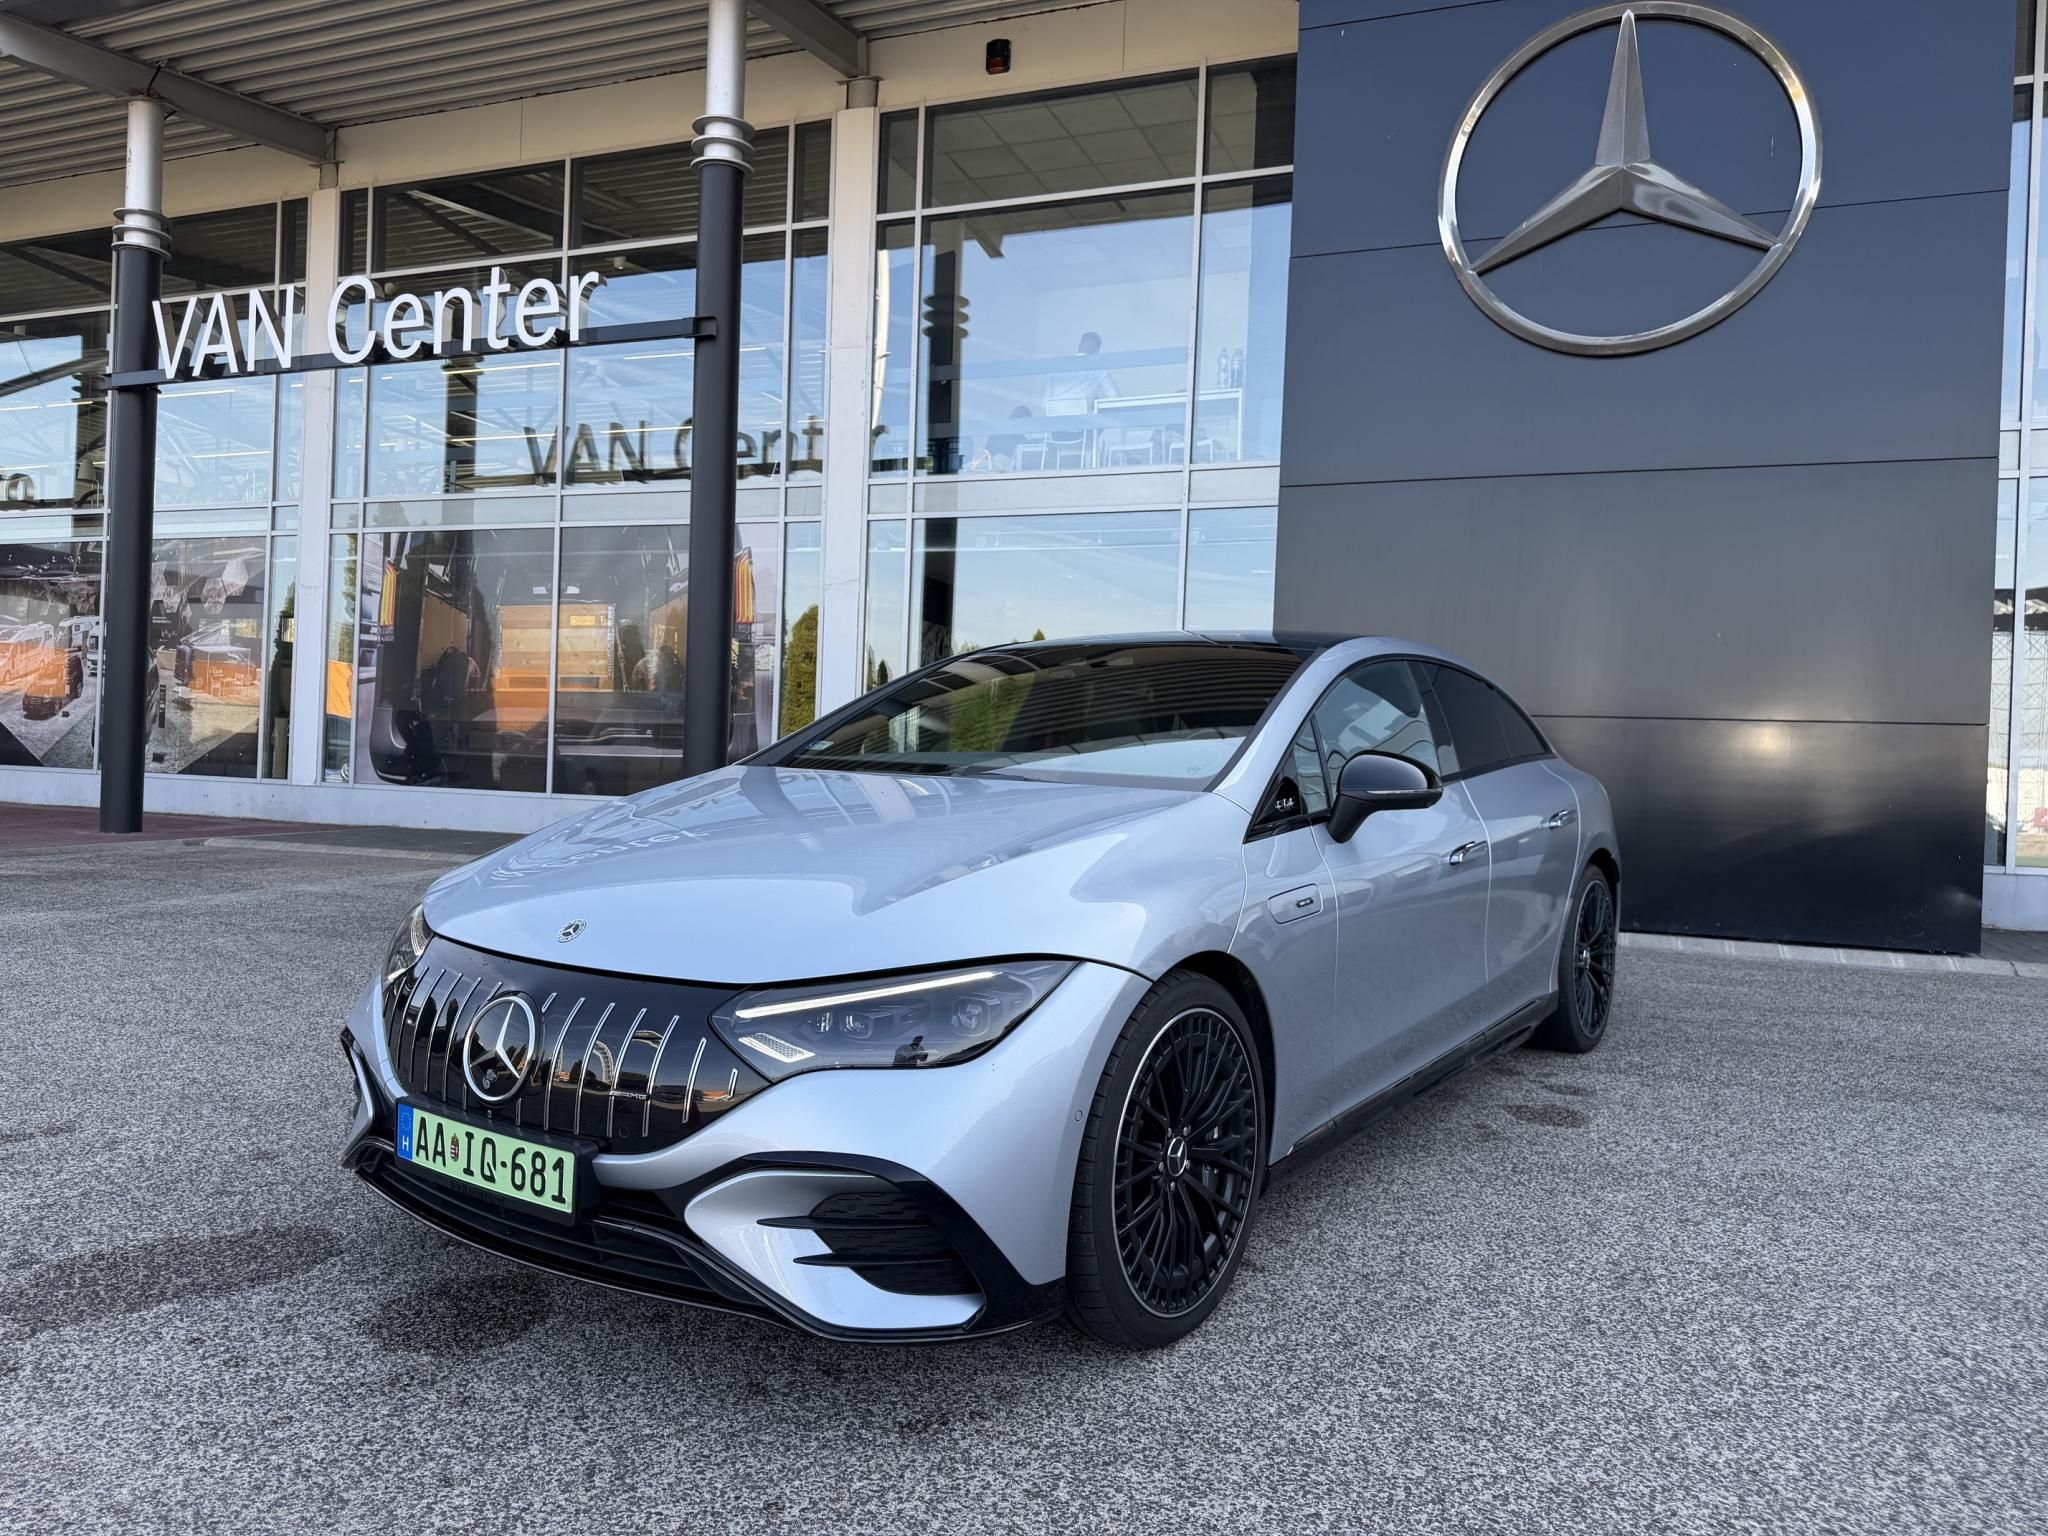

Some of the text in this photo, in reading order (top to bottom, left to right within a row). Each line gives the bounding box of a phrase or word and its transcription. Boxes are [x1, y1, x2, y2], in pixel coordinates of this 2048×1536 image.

[151, 266, 600, 380] VAN Center
[523, 420, 648, 486] VAN
[402, 1135, 409, 1152] H
